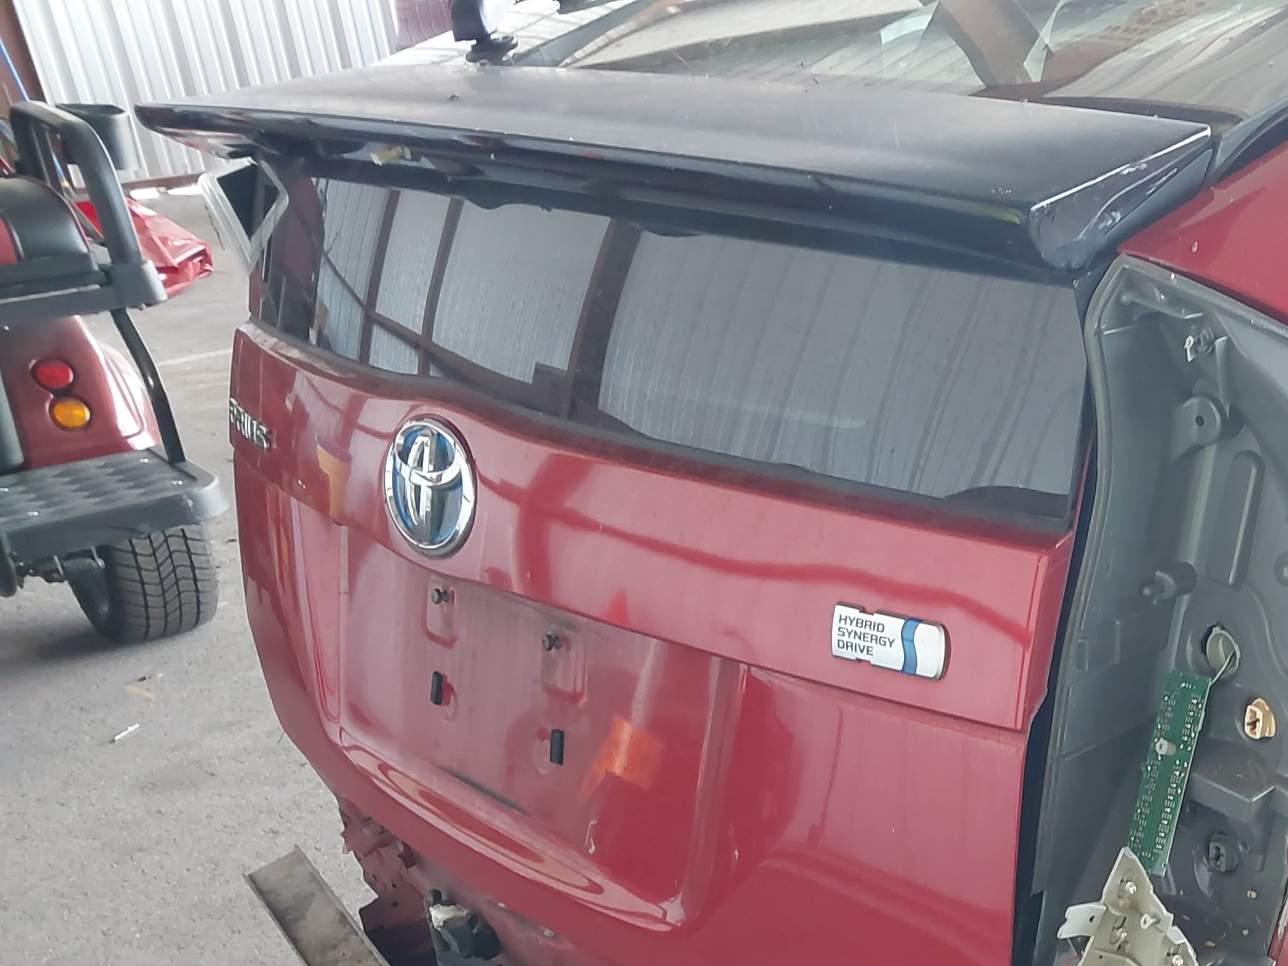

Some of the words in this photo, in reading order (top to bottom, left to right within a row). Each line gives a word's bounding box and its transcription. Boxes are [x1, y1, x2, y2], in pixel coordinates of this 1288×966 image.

[838, 613, 886, 633] HYBRID
[837, 626, 896, 648] SYNERGY
[837, 639, 874, 656] DRIVE
